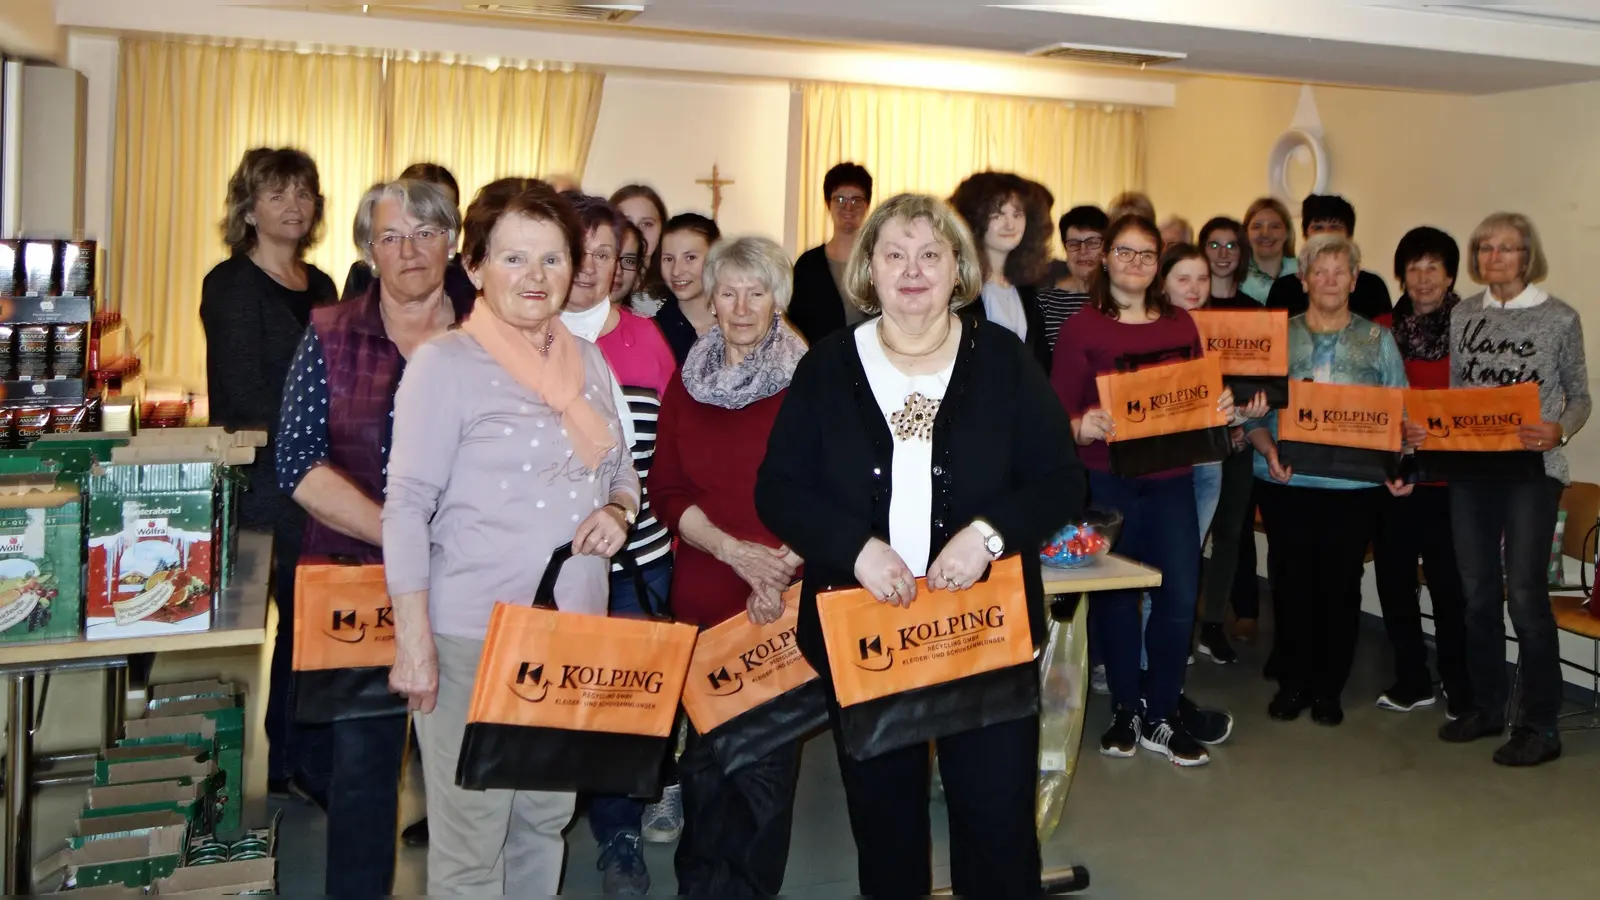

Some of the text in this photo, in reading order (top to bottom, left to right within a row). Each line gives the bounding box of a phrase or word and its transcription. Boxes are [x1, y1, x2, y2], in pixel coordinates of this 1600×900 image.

[1206, 338, 1271, 352] KOLPING
[1149, 384, 1208, 411] KOLPING
[1323, 410, 1389, 426] KOLPING
[1452, 412, 1522, 429] KOLPING
[897, 605, 1005, 650] KOLPING
[927, 640, 961, 652] RECYCLING
[558, 665, 663, 694] KOLPING
